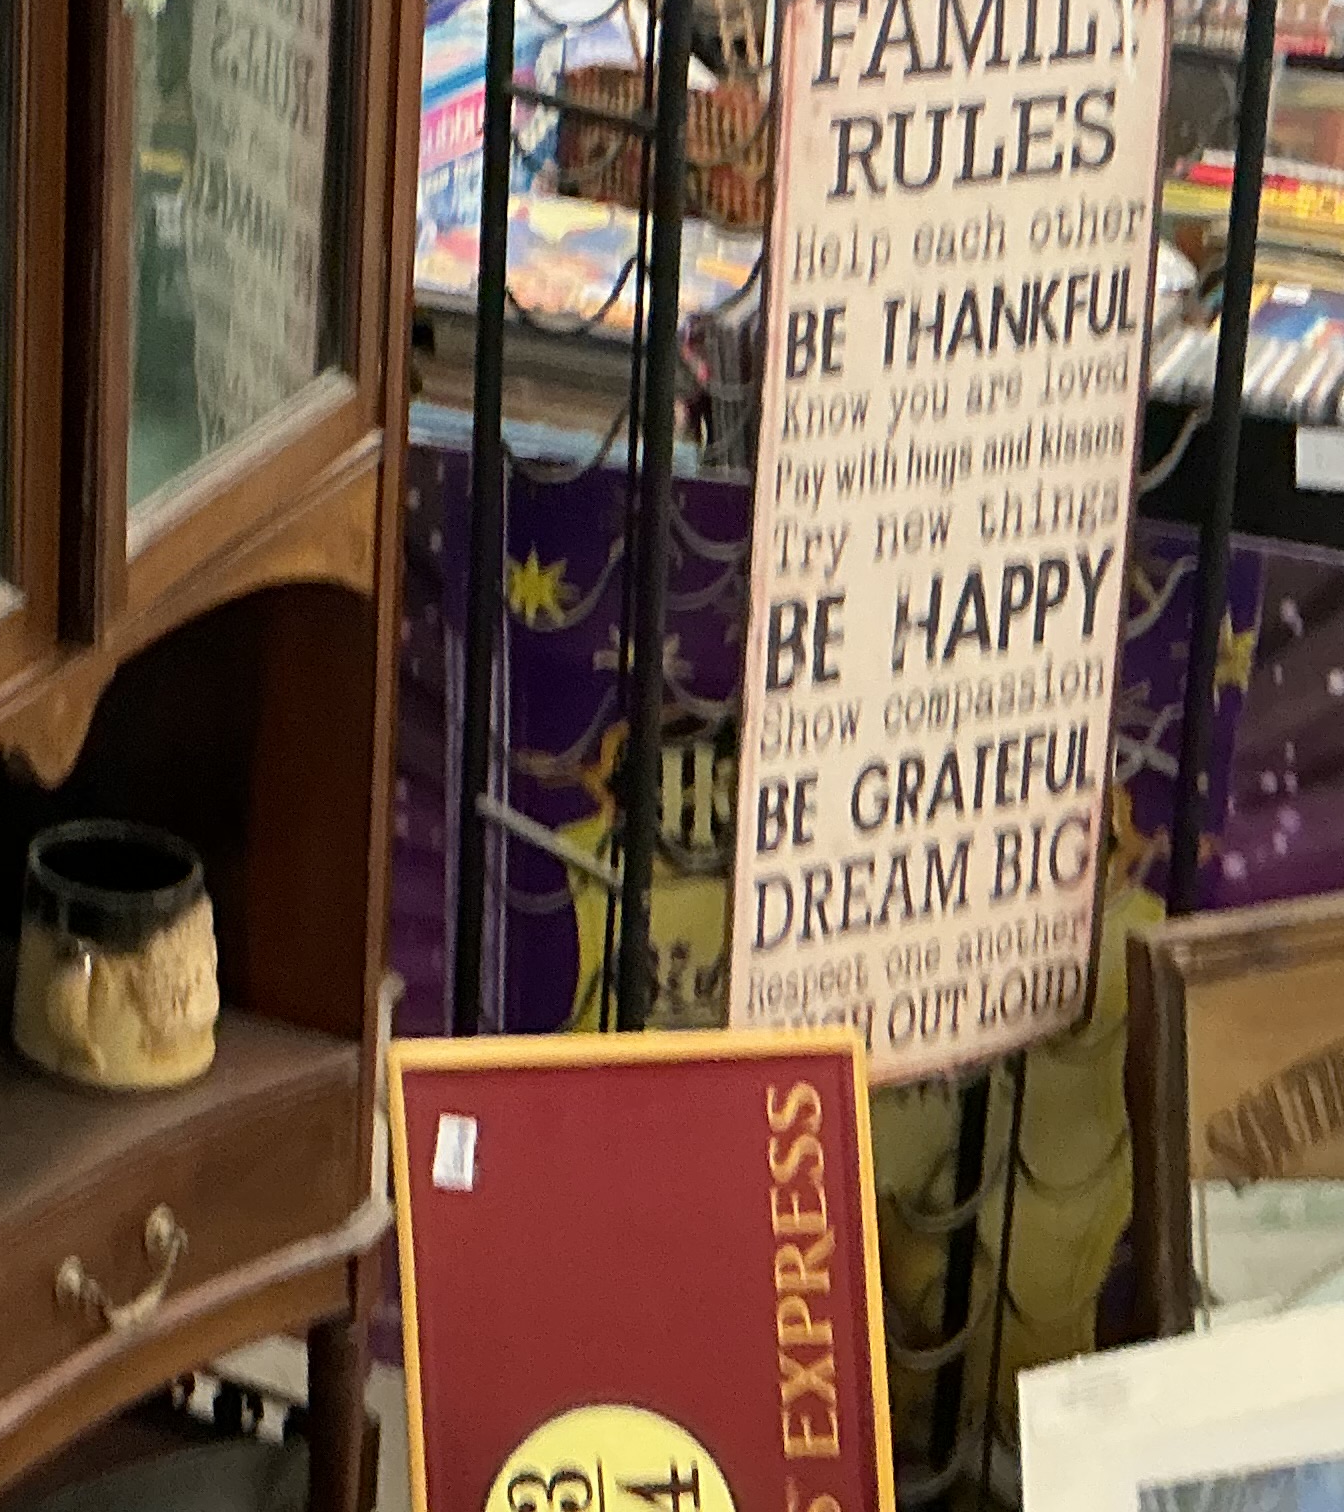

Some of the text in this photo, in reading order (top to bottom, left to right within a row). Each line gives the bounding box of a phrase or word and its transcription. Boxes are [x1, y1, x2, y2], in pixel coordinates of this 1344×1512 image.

[827, 89, 1117, 204] RULES
[791, 194, 1147, 283] Help each other
[785, 266, 1136, 379] BE THANKFUL
[782, 348, 1130, 441] Know you are loved
[775, 414, 1125, 510] Pay with hugs and kisses
[774, 478, 1120, 579] Try new things
[765, 548, 1114, 690] BE HAPPY
[760, 654, 1106, 760] Show compassion
[756, 775, 818, 854] BE
[850, 724, 1096, 831] GRATEFUL
[752, 816, 1094, 953] DREAM BIG
[747, 914, 1080, 1018] Respect one another
[888, 982, 968, 1047] OUT
[978, 958, 1081, 1025] LOUD
[766, 1080, 841, 1461] EXPRESS
